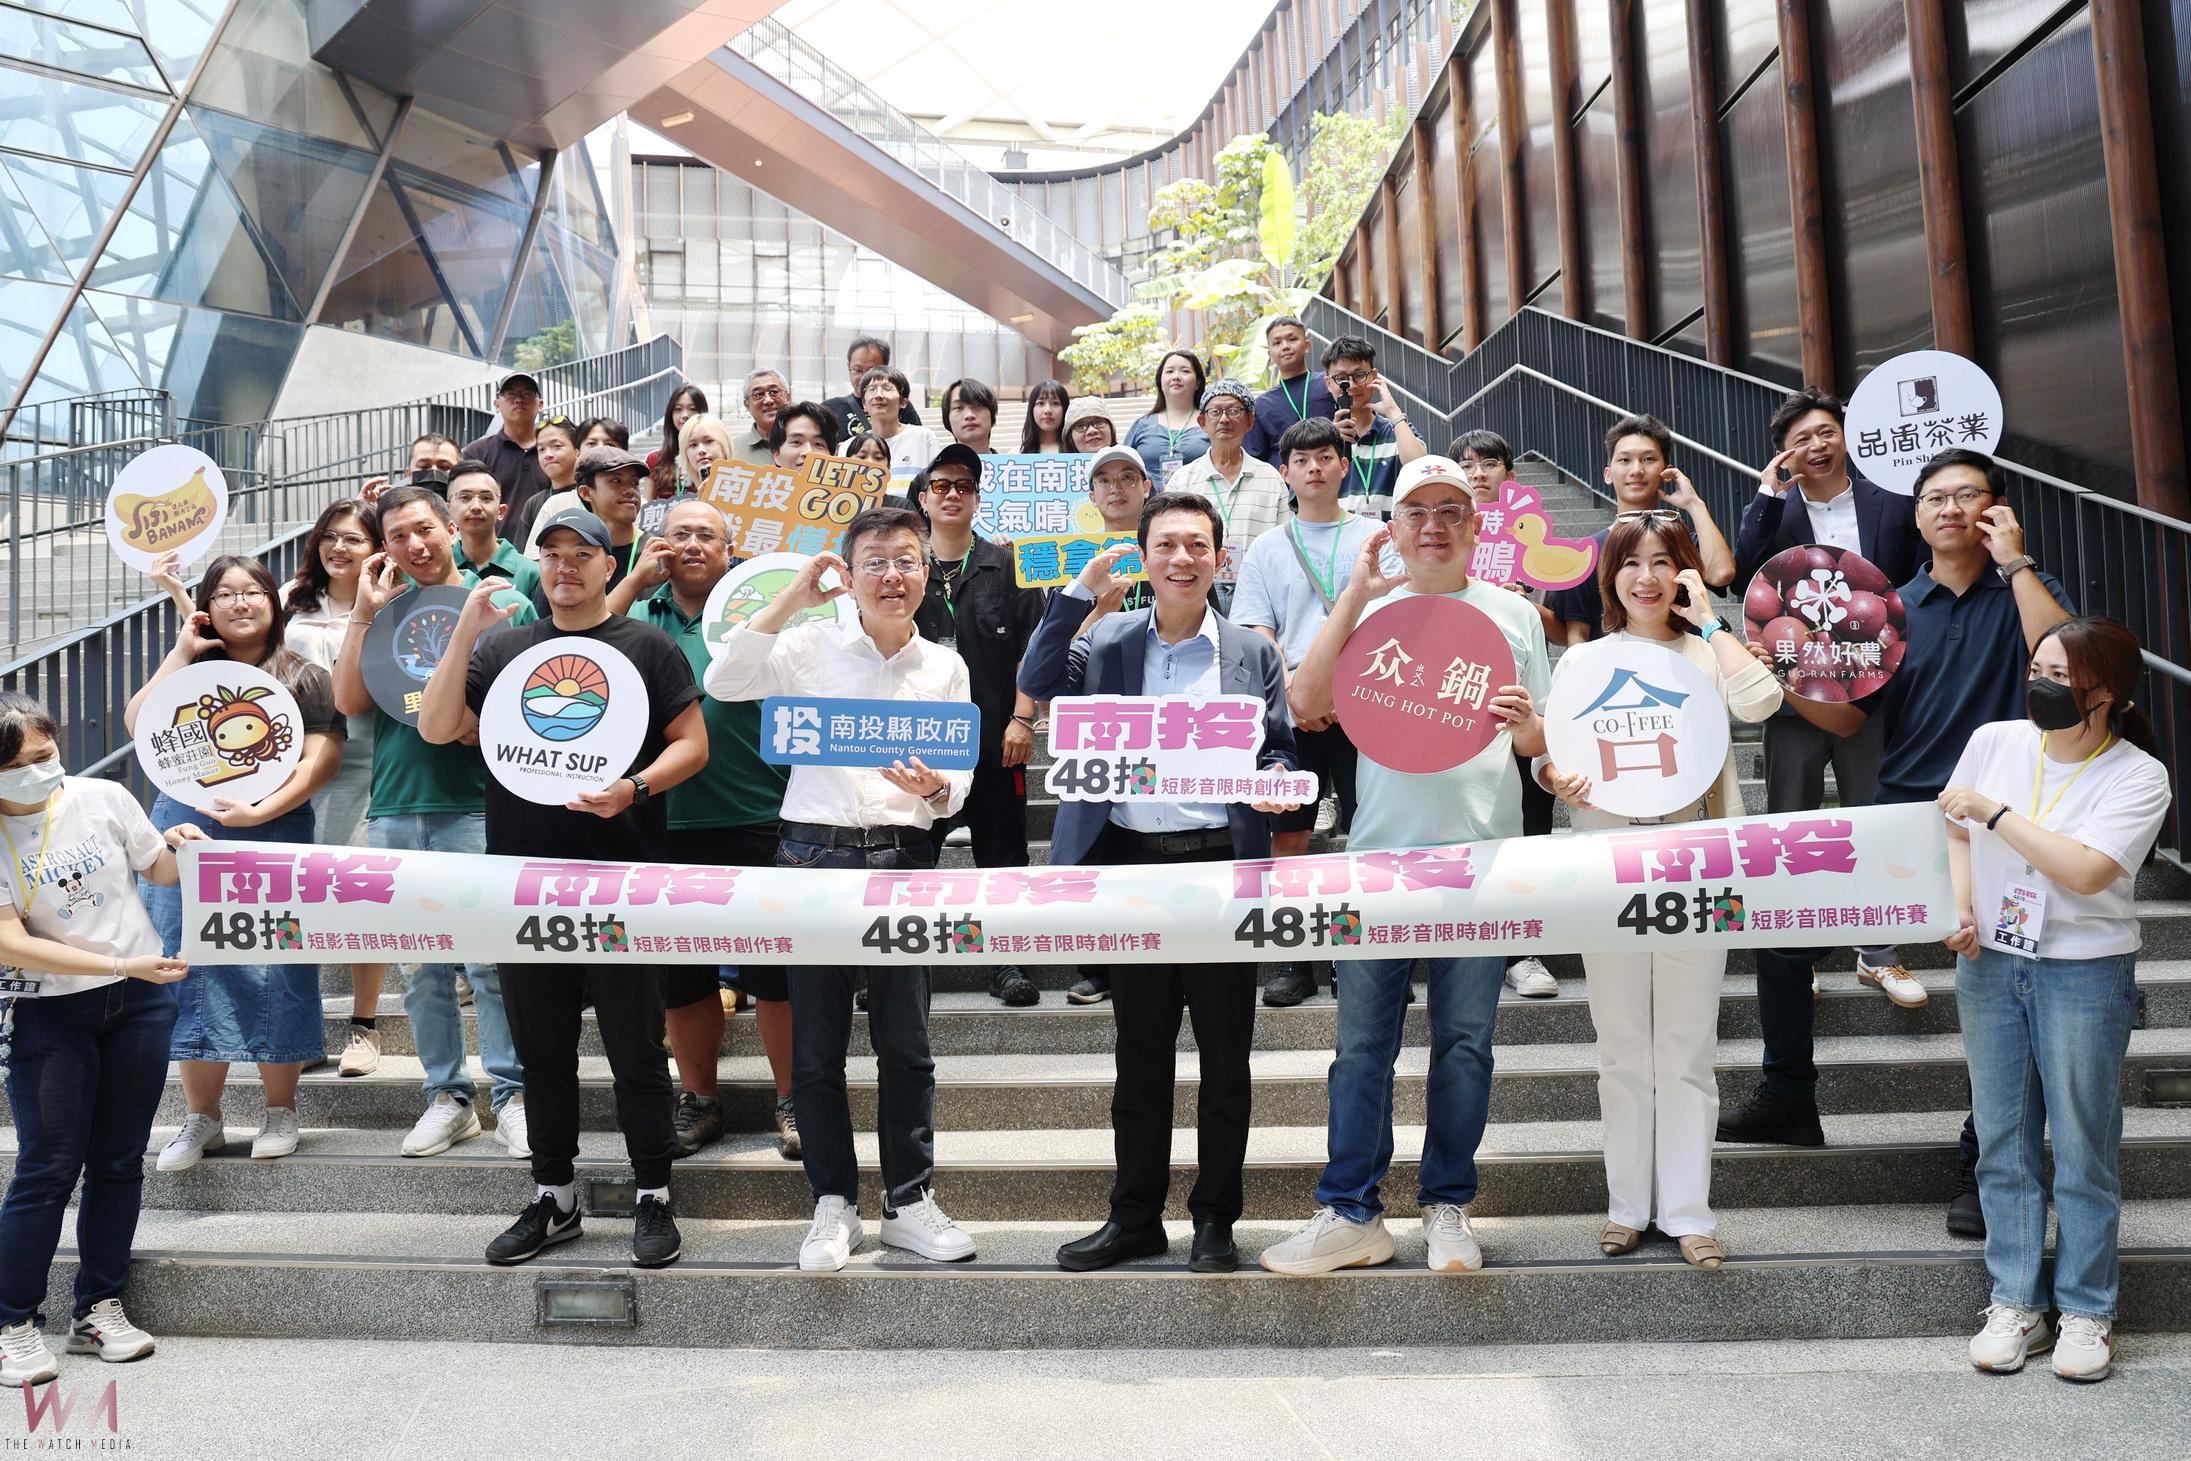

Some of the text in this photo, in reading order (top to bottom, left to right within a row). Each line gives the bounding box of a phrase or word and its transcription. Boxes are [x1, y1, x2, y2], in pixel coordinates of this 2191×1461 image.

[807, 457, 886, 495] LET'S
[1893, 458, 1913, 468] Pin
[708, 465, 795, 513] 南投
[146, 506, 207, 545] BANANA
[971, 499, 1070, 534] 天氣晴
[1471, 540, 1517, 583] 鴨
[1774, 639, 1882, 667] 果然好農
[1841, 670, 1884, 679] FARMS
[1055, 702, 1258, 751] 南投
[1351, 685, 1476, 732] JUNG HOT POT
[151, 720, 209, 757] 蜂國
[773, 706, 822, 755] 投
[829, 714, 971, 744] 南投縣政府
[157, 745, 213, 771] 蜂蜜莊園
[177, 758, 216, 774] Fung Guo
[497, 743, 608, 774] WHAT SUP
[830, 743, 970, 757] Nantou County Government
[165, 767, 219, 788] Honey Manor
[519, 766, 605, 783] PROFESSIONAL INSTRUCTION
[1052, 756, 1311, 797] 48拍 短影音限時創作賽
[21, 834, 100, 874] ASTRONAUT
[25, 851, 108, 890] MICKEY
[1608, 818, 1858, 884] 南投
[198, 850, 403, 904] 南投
[513, 861, 744, 907] 南投
[862, 869, 1100, 907] 南投
[1232, 847, 1476, 899] 南投
[200, 910, 455, 951] 48拍 短影音限時創作賽
[1234, 902, 1544, 949] 48拍 短影音限時創作賽
[1617, 887, 1928, 936] 48拍 短影音限時創作賽
[515, 912, 794, 955] 48拍 短影音限時創作賽
[861, 912, 1162, 955] 48拍 短影音限時創作賽
